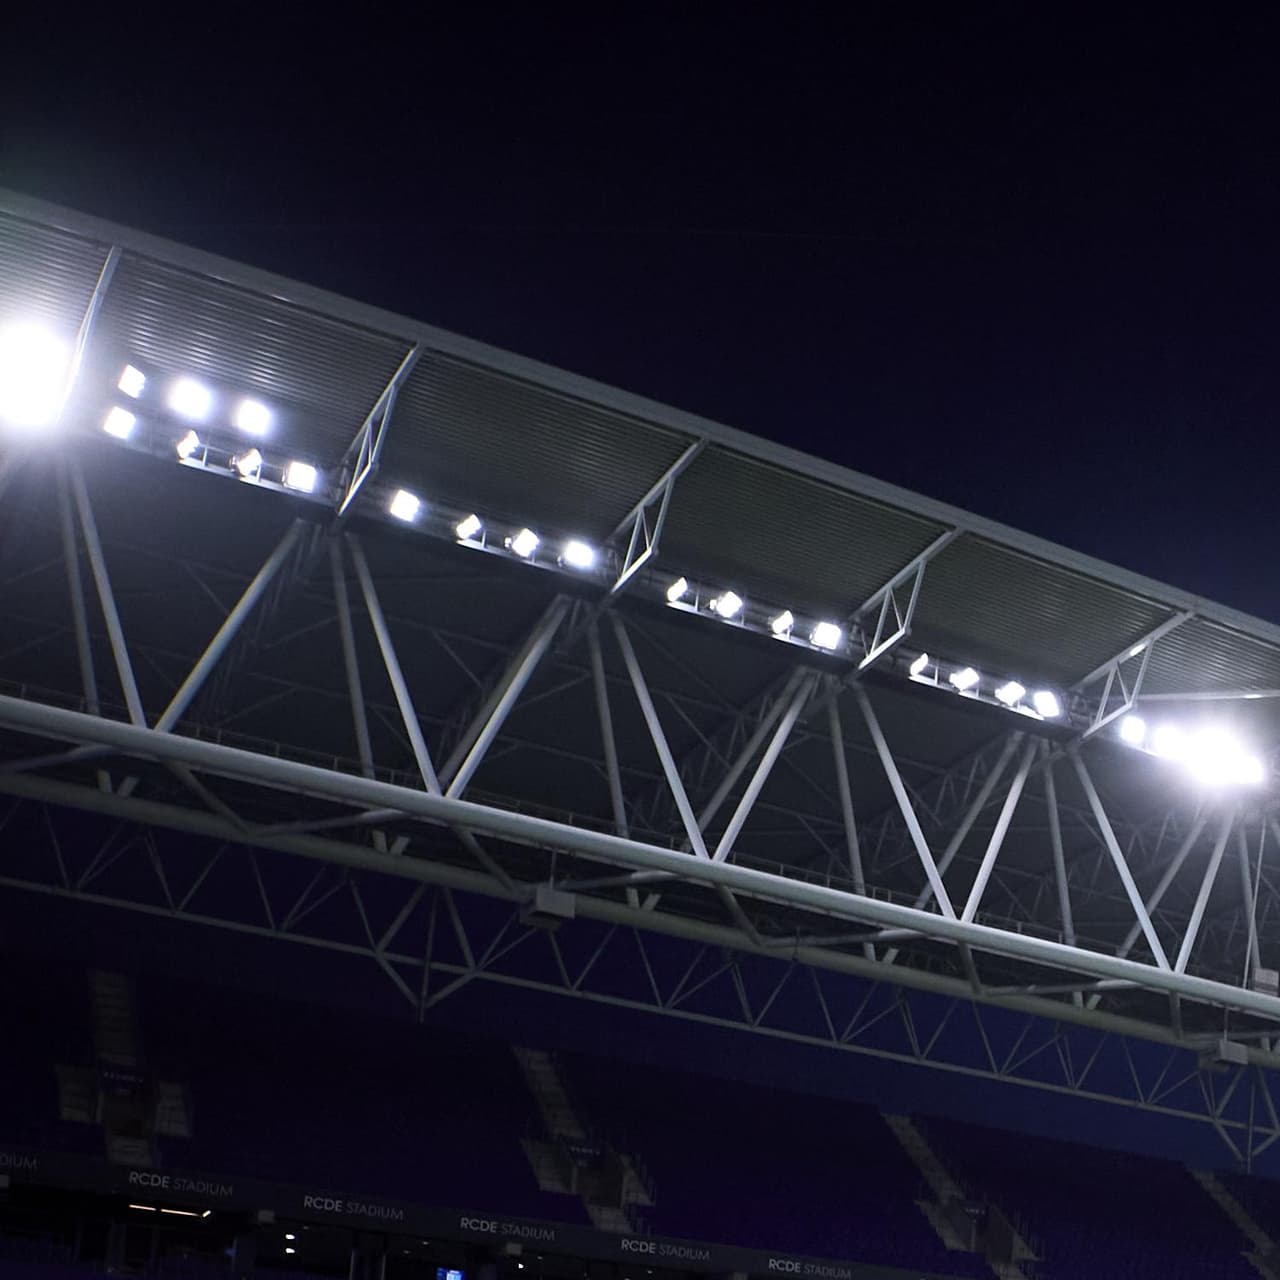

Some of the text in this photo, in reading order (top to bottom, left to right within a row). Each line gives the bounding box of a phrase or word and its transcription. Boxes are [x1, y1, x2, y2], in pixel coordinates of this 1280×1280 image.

[129, 1171, 233, 1197] RCDE STADIUM
[304, 1195, 404, 1220] RCDE STADIUM
[460, 1217, 556, 1241] RCDE STADIUM
[621, 1239, 711, 1261] RCDE STADIUM
[768, 1258, 851, 1280] RCDE STADIUM
